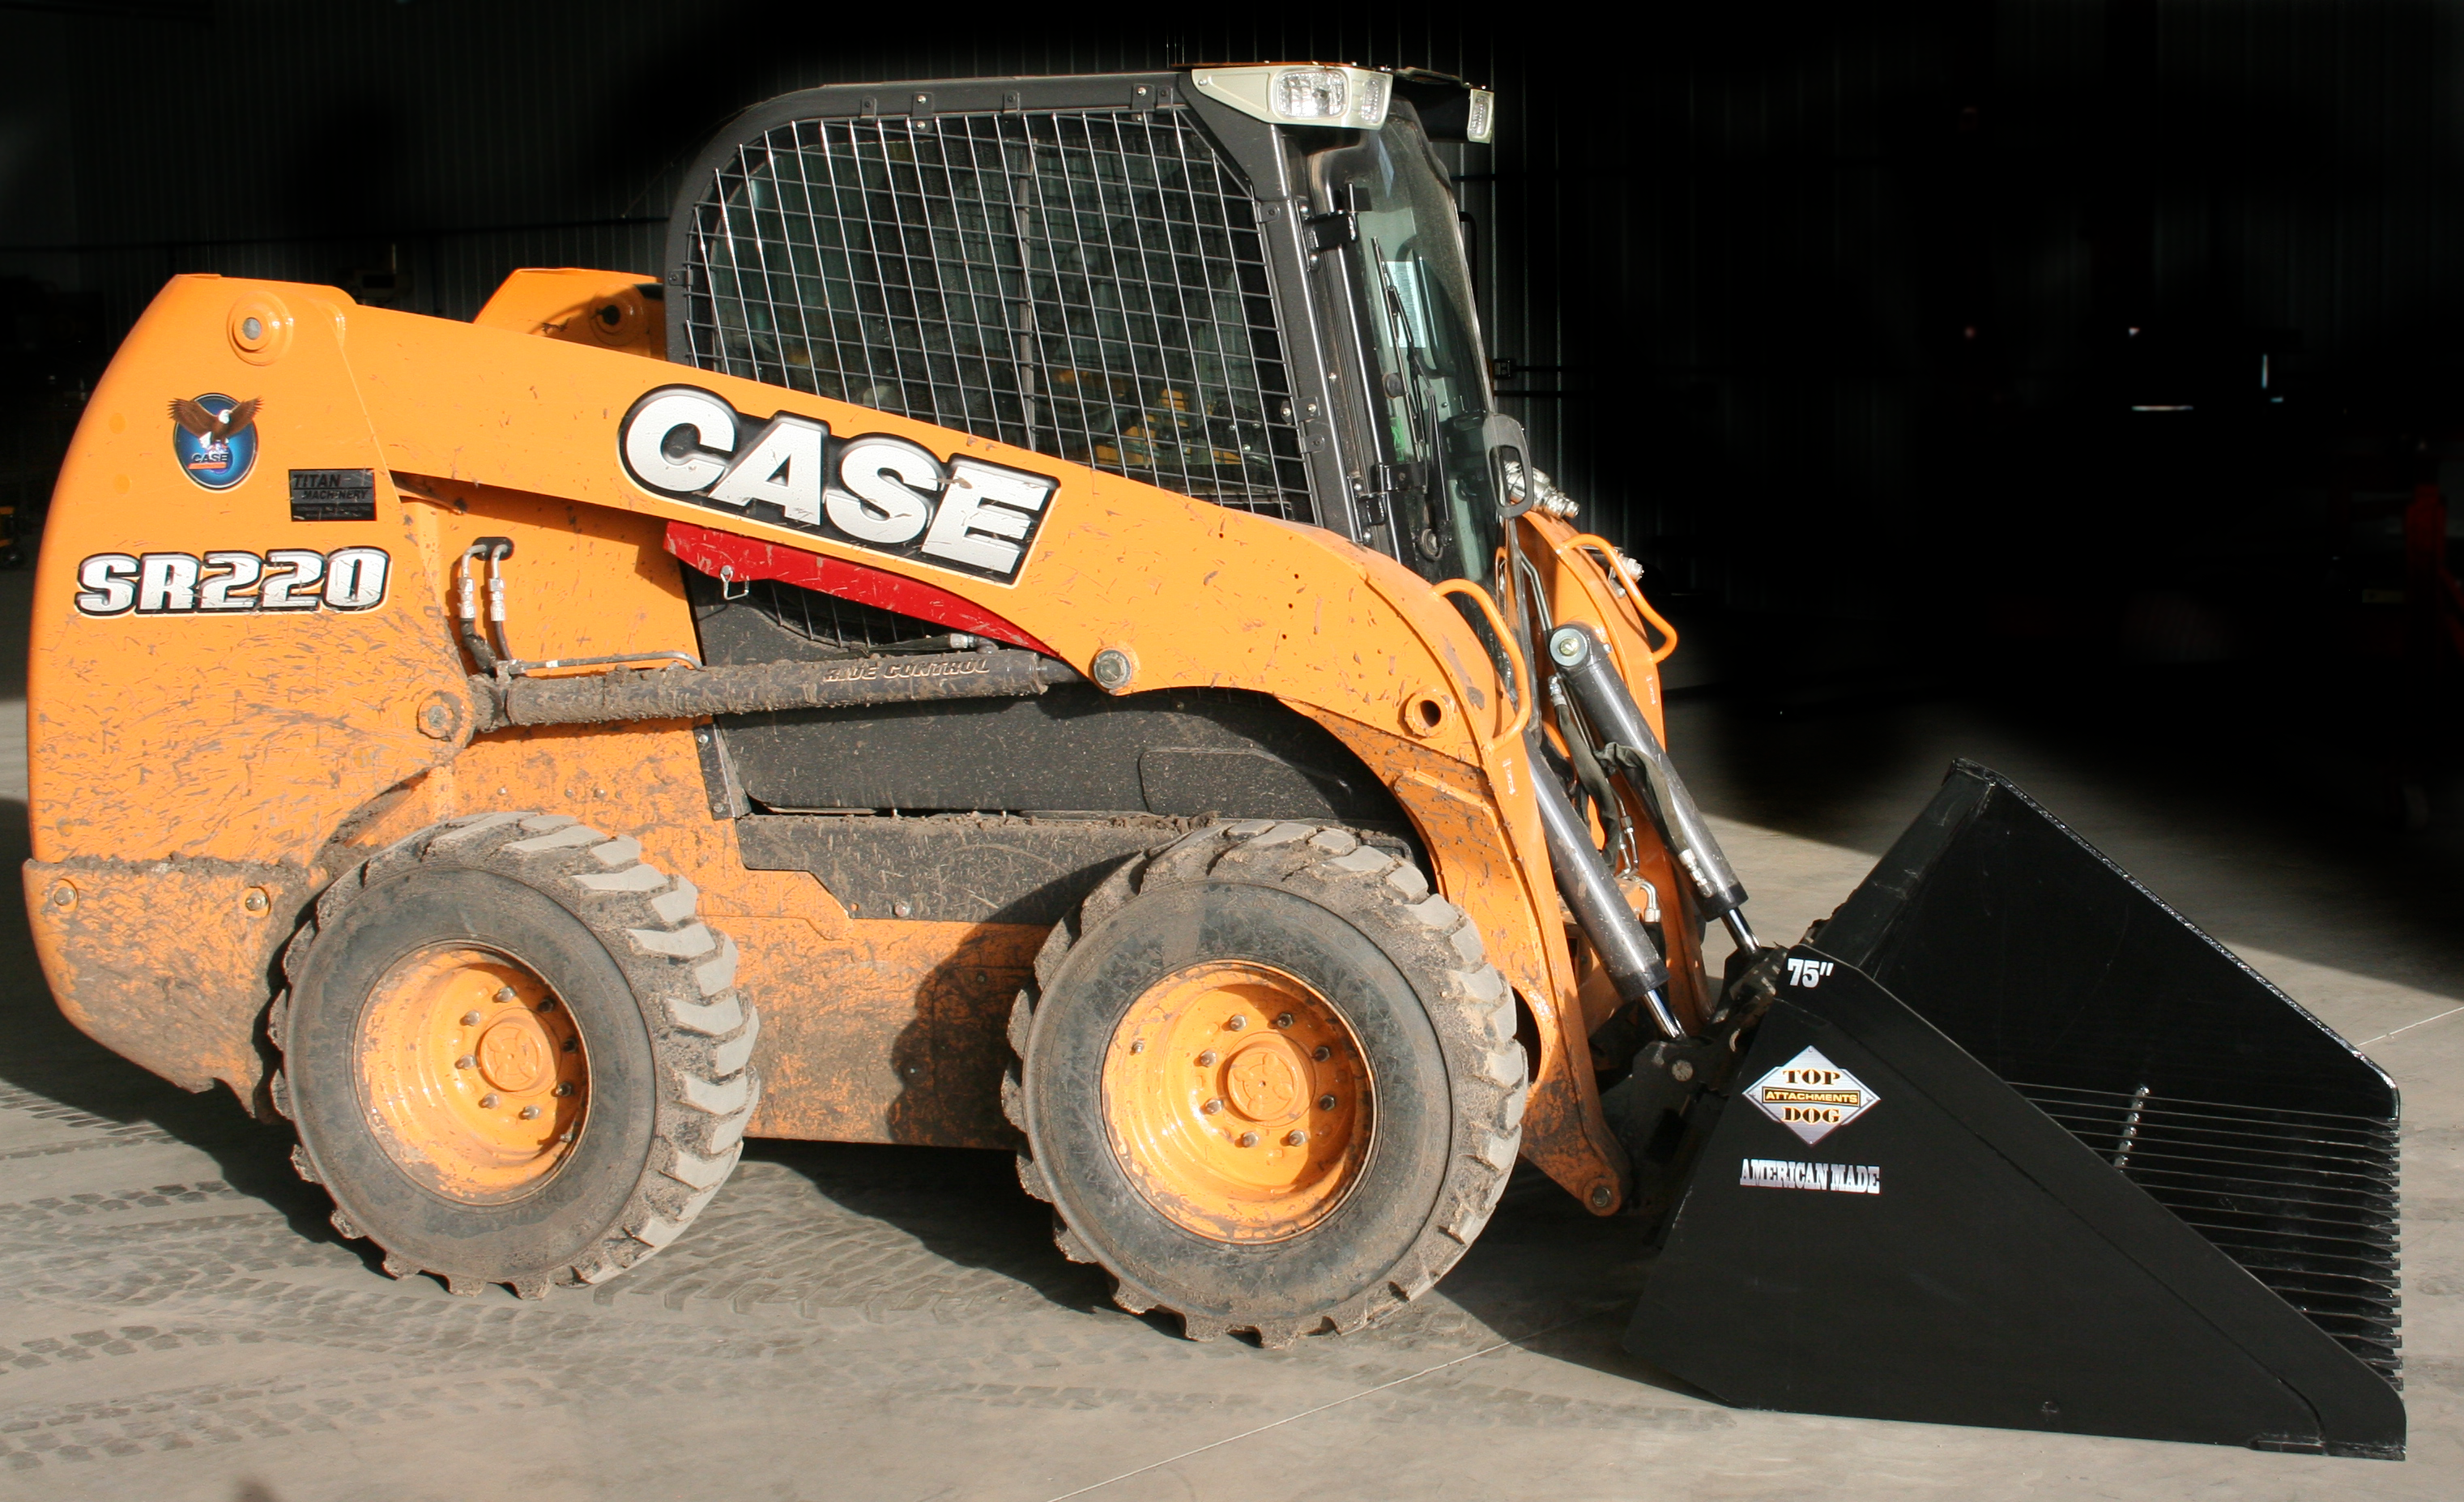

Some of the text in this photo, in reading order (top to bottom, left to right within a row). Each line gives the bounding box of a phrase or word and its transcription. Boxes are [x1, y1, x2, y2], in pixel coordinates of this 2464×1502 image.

[191, 451, 229, 463] CASE
[293, 474, 342, 488] TITAN
[624, 389, 1055, 575] CASE
[302, 489, 369, 500] MACHINERY
[75, 546, 390, 615] SR220
[1787, 958, 1834, 988] 75"
[1783, 1069, 1841, 1085] TOP
[1765, 1090, 1858, 1103] ATTACHMENTS
[1782, 1107, 1841, 1124] DOG
[1740, 1158, 1880, 1194] AMERICAN MADE
